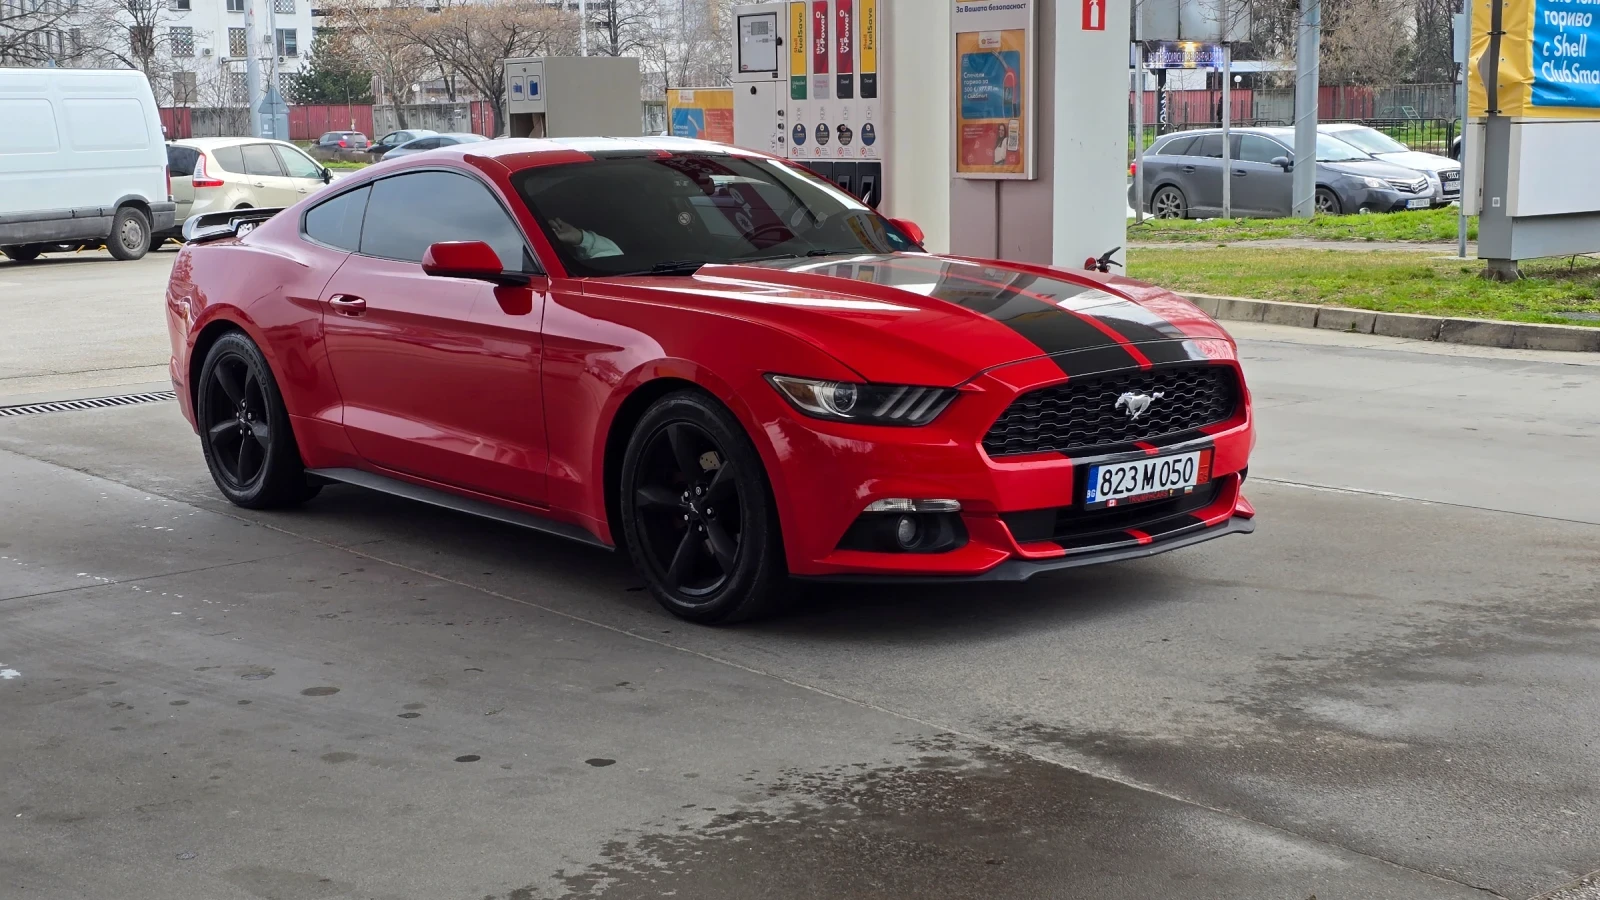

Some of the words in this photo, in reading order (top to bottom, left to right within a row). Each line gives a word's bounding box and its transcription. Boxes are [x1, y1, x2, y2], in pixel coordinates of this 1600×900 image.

[1544, 10, 1592, 32] гориво
[1554, 33, 1587, 57] Shell
[1100, 465, 1138, 496] 823
[1141, 462, 1157, 490] M
[1159, 457, 1194, 487] 050
[1086, 489, 1096, 498] BG
